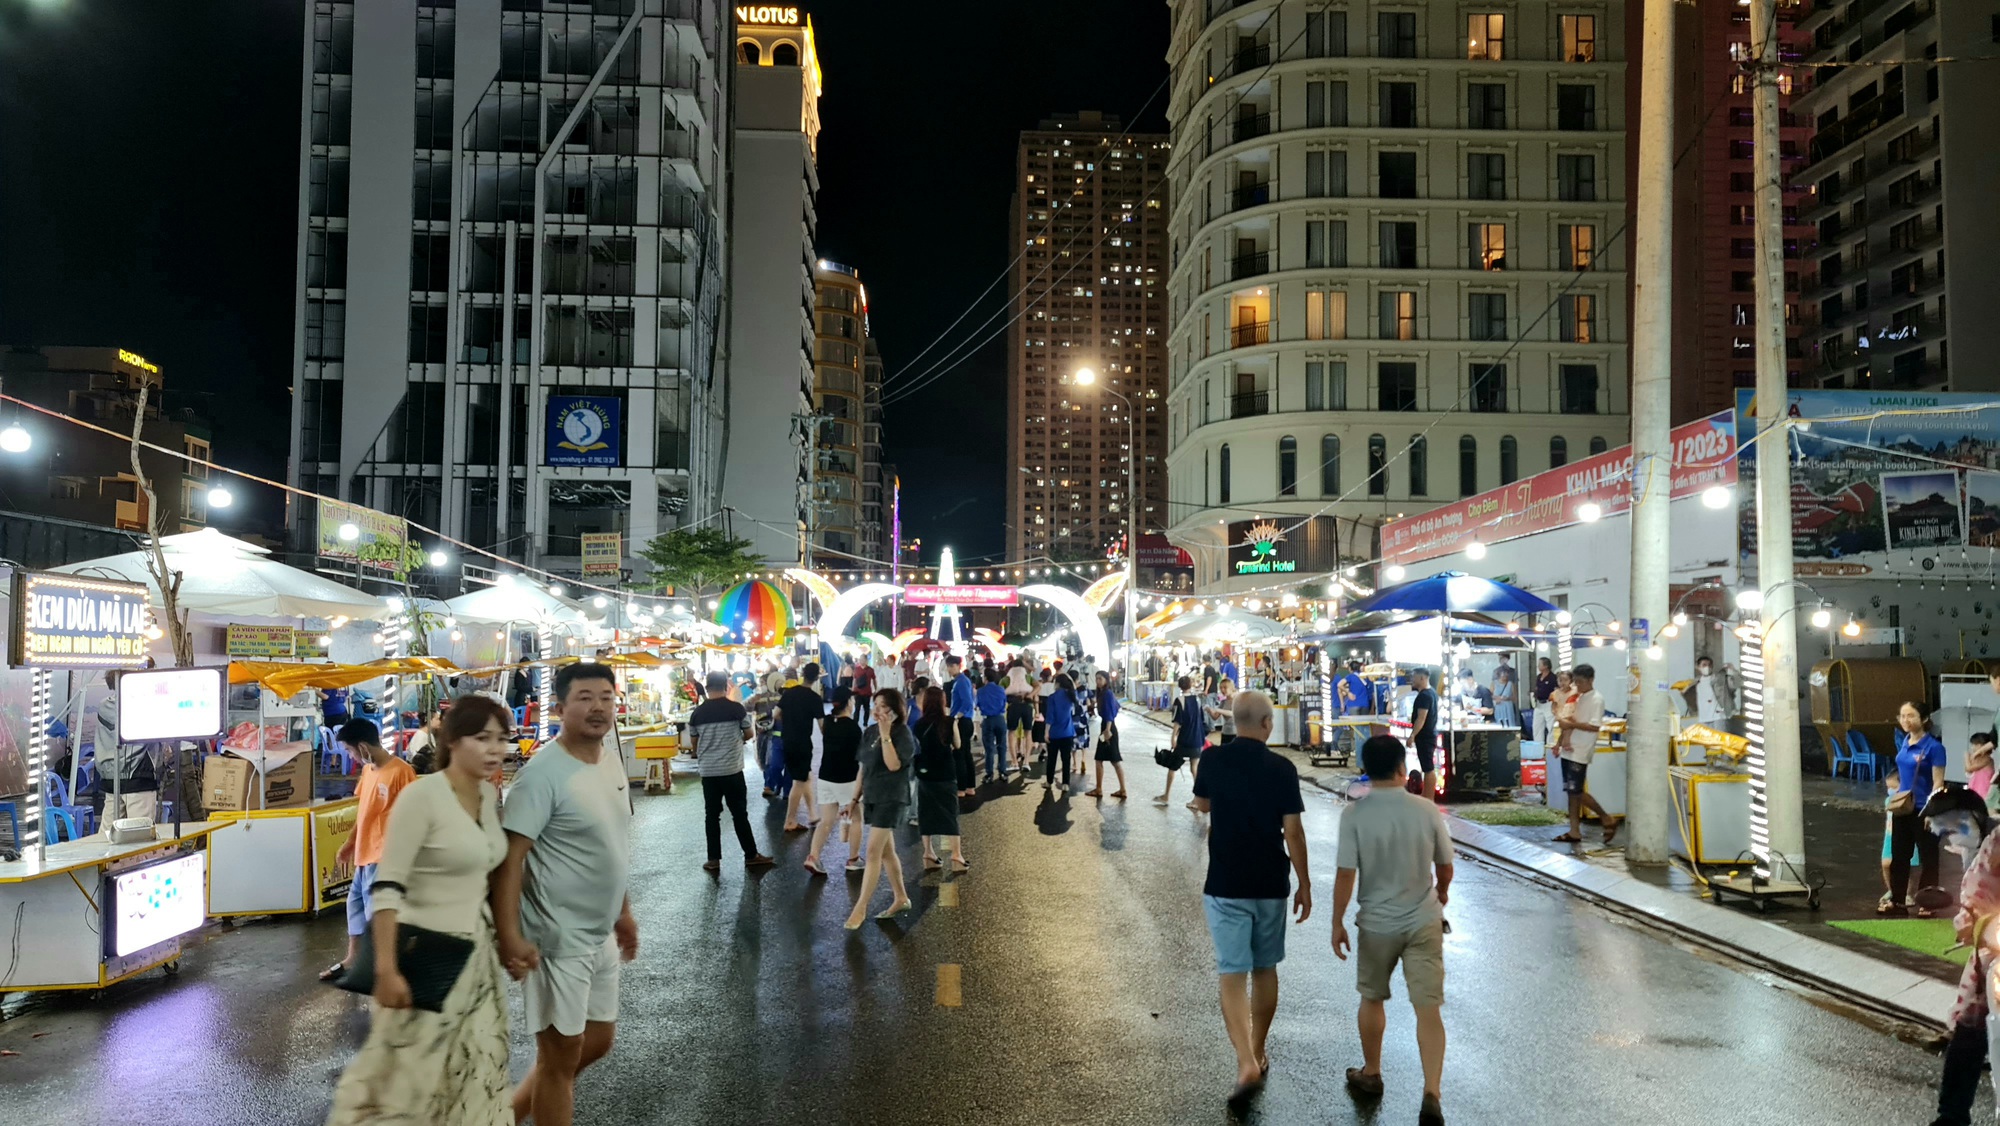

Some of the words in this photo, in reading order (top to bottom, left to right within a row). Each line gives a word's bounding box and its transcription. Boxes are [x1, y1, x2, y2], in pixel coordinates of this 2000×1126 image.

[750, 6, 798, 24] LOTUS
[1870, 397, 1907, 406] LAMAN
[1910, 397, 1939, 407] JUICE
[556, 408, 569, 429] NAM
[1894, 419, 1923, 430] selling
[1925, 420, 1956, 430] tourist
[1957, 421, 1989, 431] tickets)
[1885, 461, 1917, 472] books)
[1566, 467, 1598, 497] KHAI
[1899, 525, 1917, 540] KINH
[1236, 561, 1270, 574] Tamarind
[1272, 560, 1295, 572] Hotel
[937, 587, 958, 598] Đêm
[958, 587, 973, 598] An
[31, 592, 64, 630] KEM
[66, 589, 97, 633] DỪA
[123, 602, 145, 635] LAI
